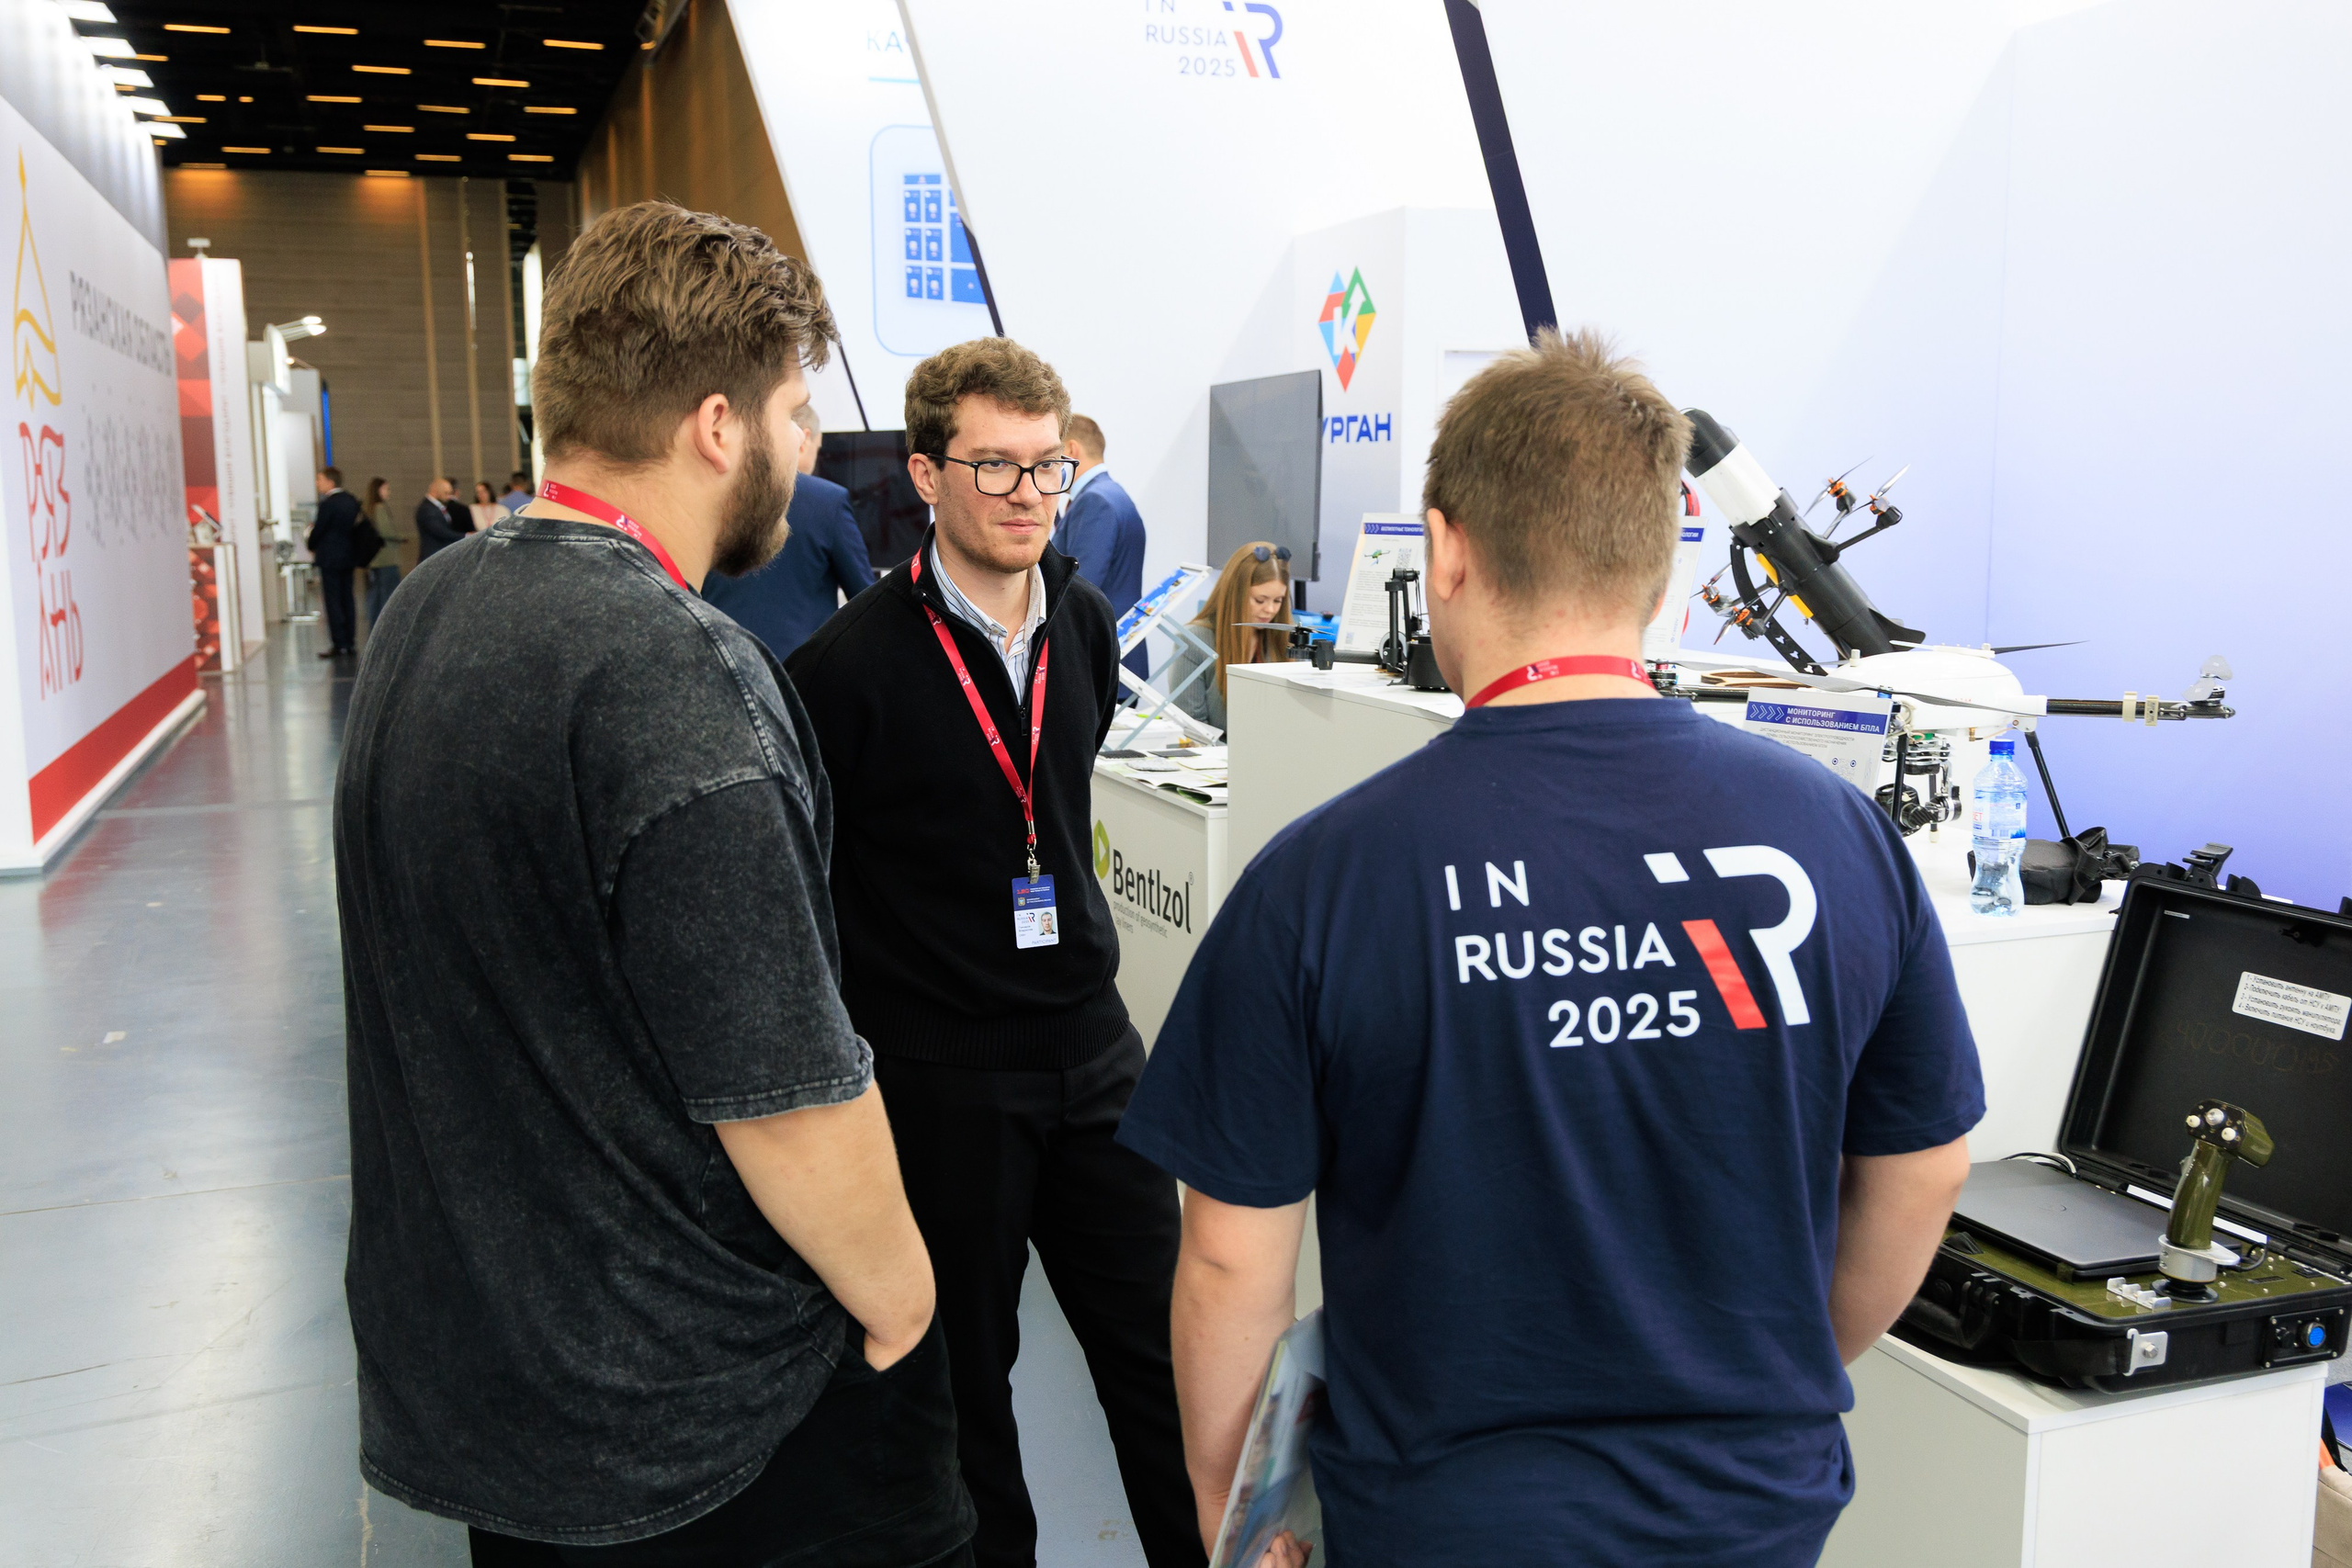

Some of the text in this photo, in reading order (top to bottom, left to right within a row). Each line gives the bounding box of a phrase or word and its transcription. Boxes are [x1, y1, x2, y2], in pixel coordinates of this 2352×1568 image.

[1146, 24, 1227, 47] RUSSIA
[1179, 56, 1235, 77] 2025
[1787, 707, 1836, 717] МОНИТОРИНГ
[1792, 717, 1860, 731] ИСПОЛЬЗОВАНИЕМ
[1860, 724, 1880, 733] БПЛА
[1454, 921, 1676, 984] RUSSIA
[1547, 989, 1701, 1047] 2025
